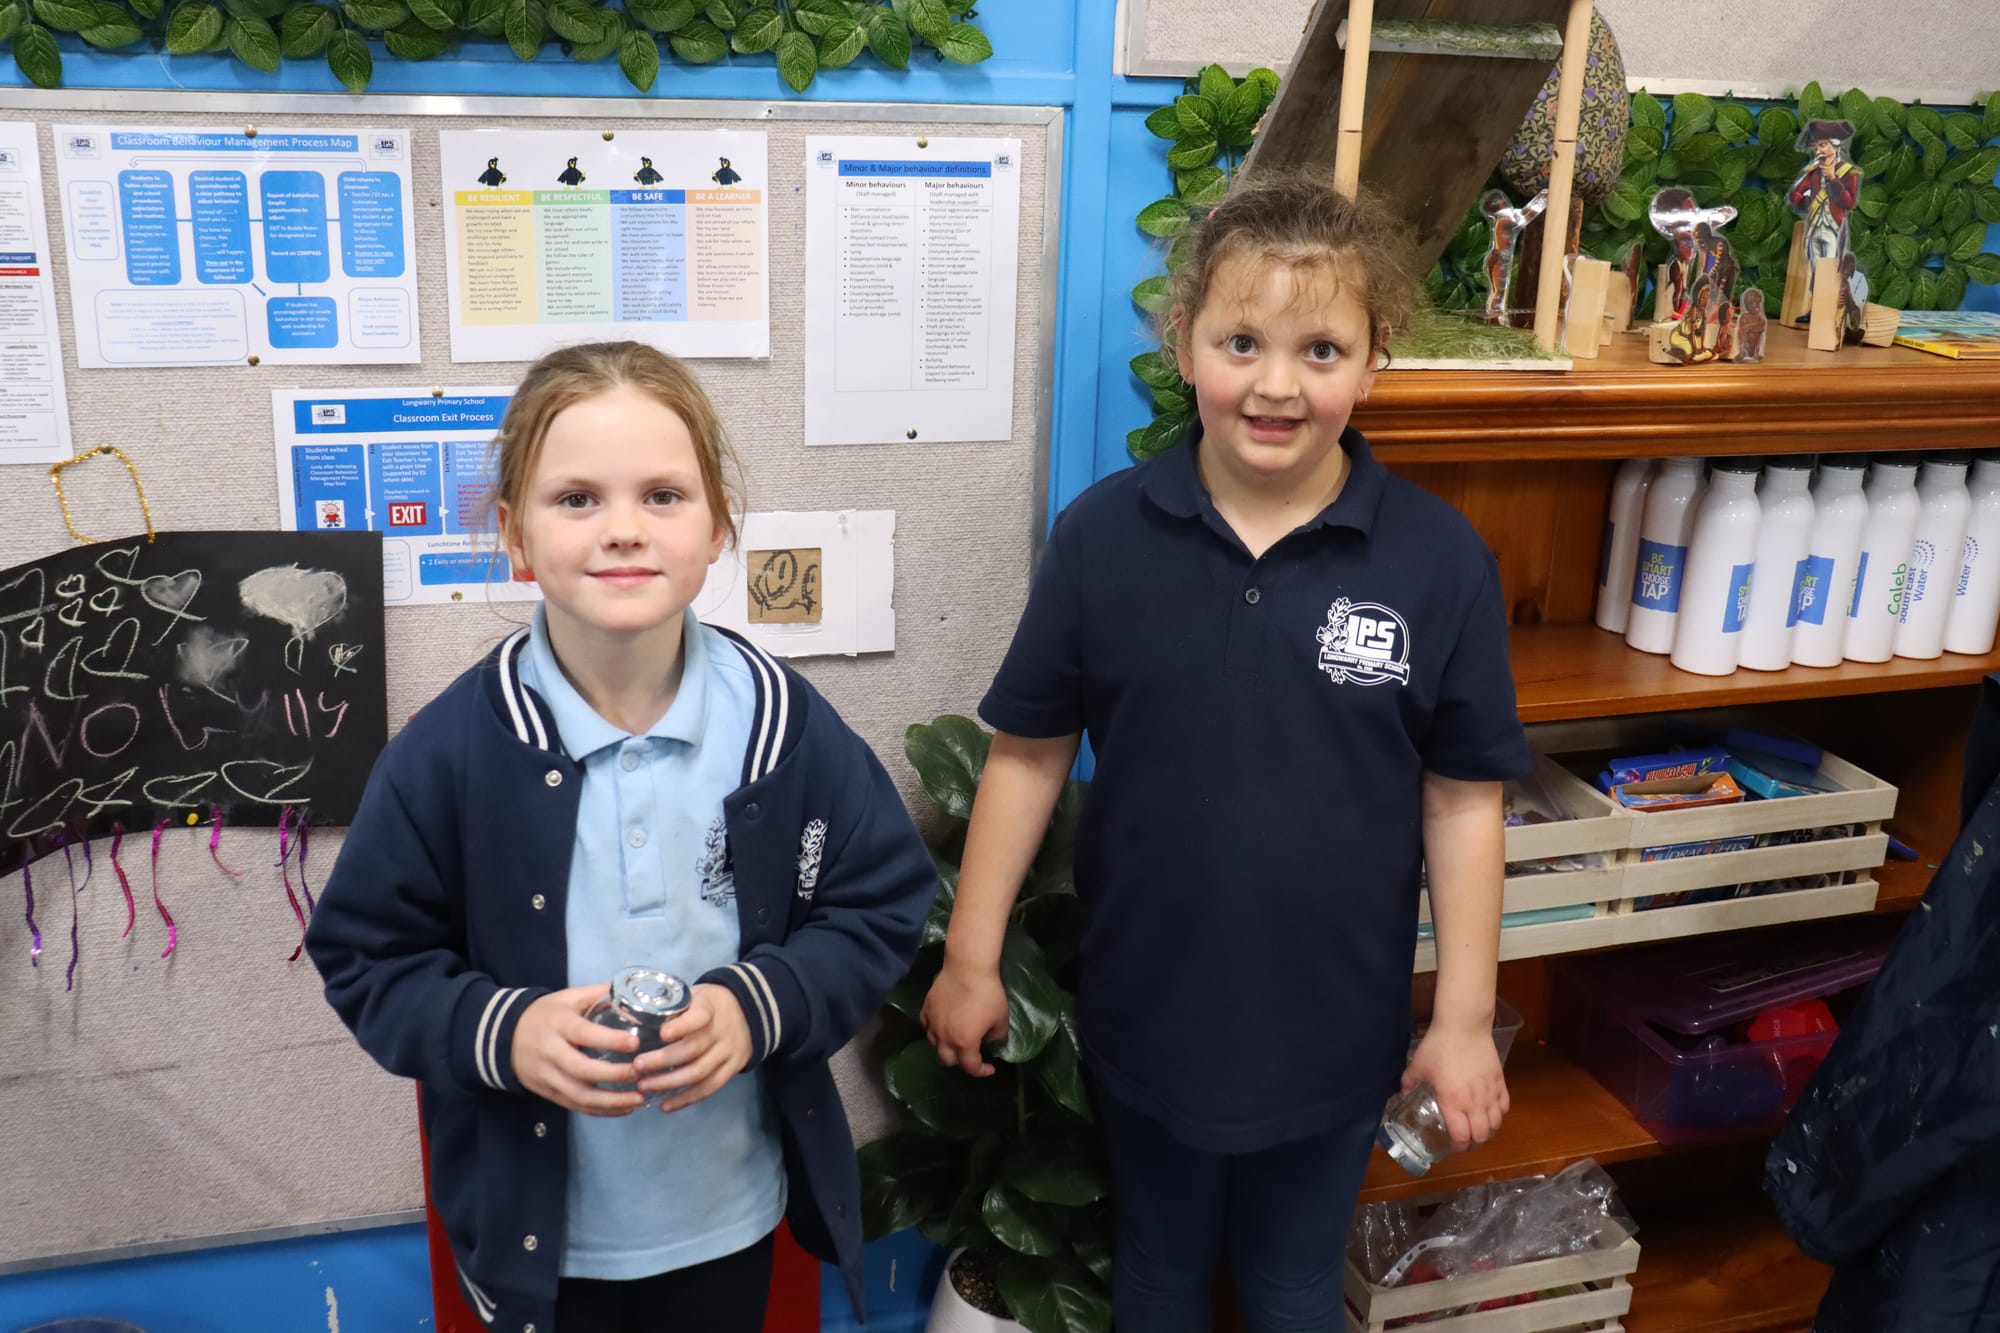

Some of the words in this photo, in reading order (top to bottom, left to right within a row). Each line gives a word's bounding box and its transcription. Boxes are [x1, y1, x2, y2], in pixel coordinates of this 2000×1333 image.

[117, 135, 170, 147] Classroom
[172, 136, 222, 148] Behaviour
[226, 137, 288, 150] Management
[292, 138, 328, 148] Process
[331, 138, 352, 150] Map
[844, 164, 868, 173] Minor
[870, 164, 877, 173] &
[879, 164, 902, 175] Major
[904, 164, 943, 174] behaviour
[944, 164, 986, 174] definitions
[846, 180, 866, 189] Minor
[868, 180, 906, 189] behaviours
[924, 182, 944, 190] Major
[541, 193, 550, 202] BE
[553, 193, 602, 202] RESPECTFUL
[632, 192, 642, 201] BE
[644, 192, 664, 201] SAFE
[696, 192, 706, 202] BE
[708, 192, 714, 202] A
[716, 192, 752, 202] LEARNER
[402, 400, 436, 408] Longwarry
[394, 414, 439, 423] Classroom
[442, 414, 458, 422] Exit
[460, 413, 494, 422] Process
[392, 506, 424, 524] EXIT
[1652, 553, 1664, 564] BE
[1642, 561, 1674, 576] SMART
[1642, 572, 1670, 585] CHOOSE
[1956, 564, 1970, 597] Water
[1642, 581, 1669, 600] TAP
[1888, 563, 1906, 615] Caleb
[1914, 569, 1928, 602] Water
